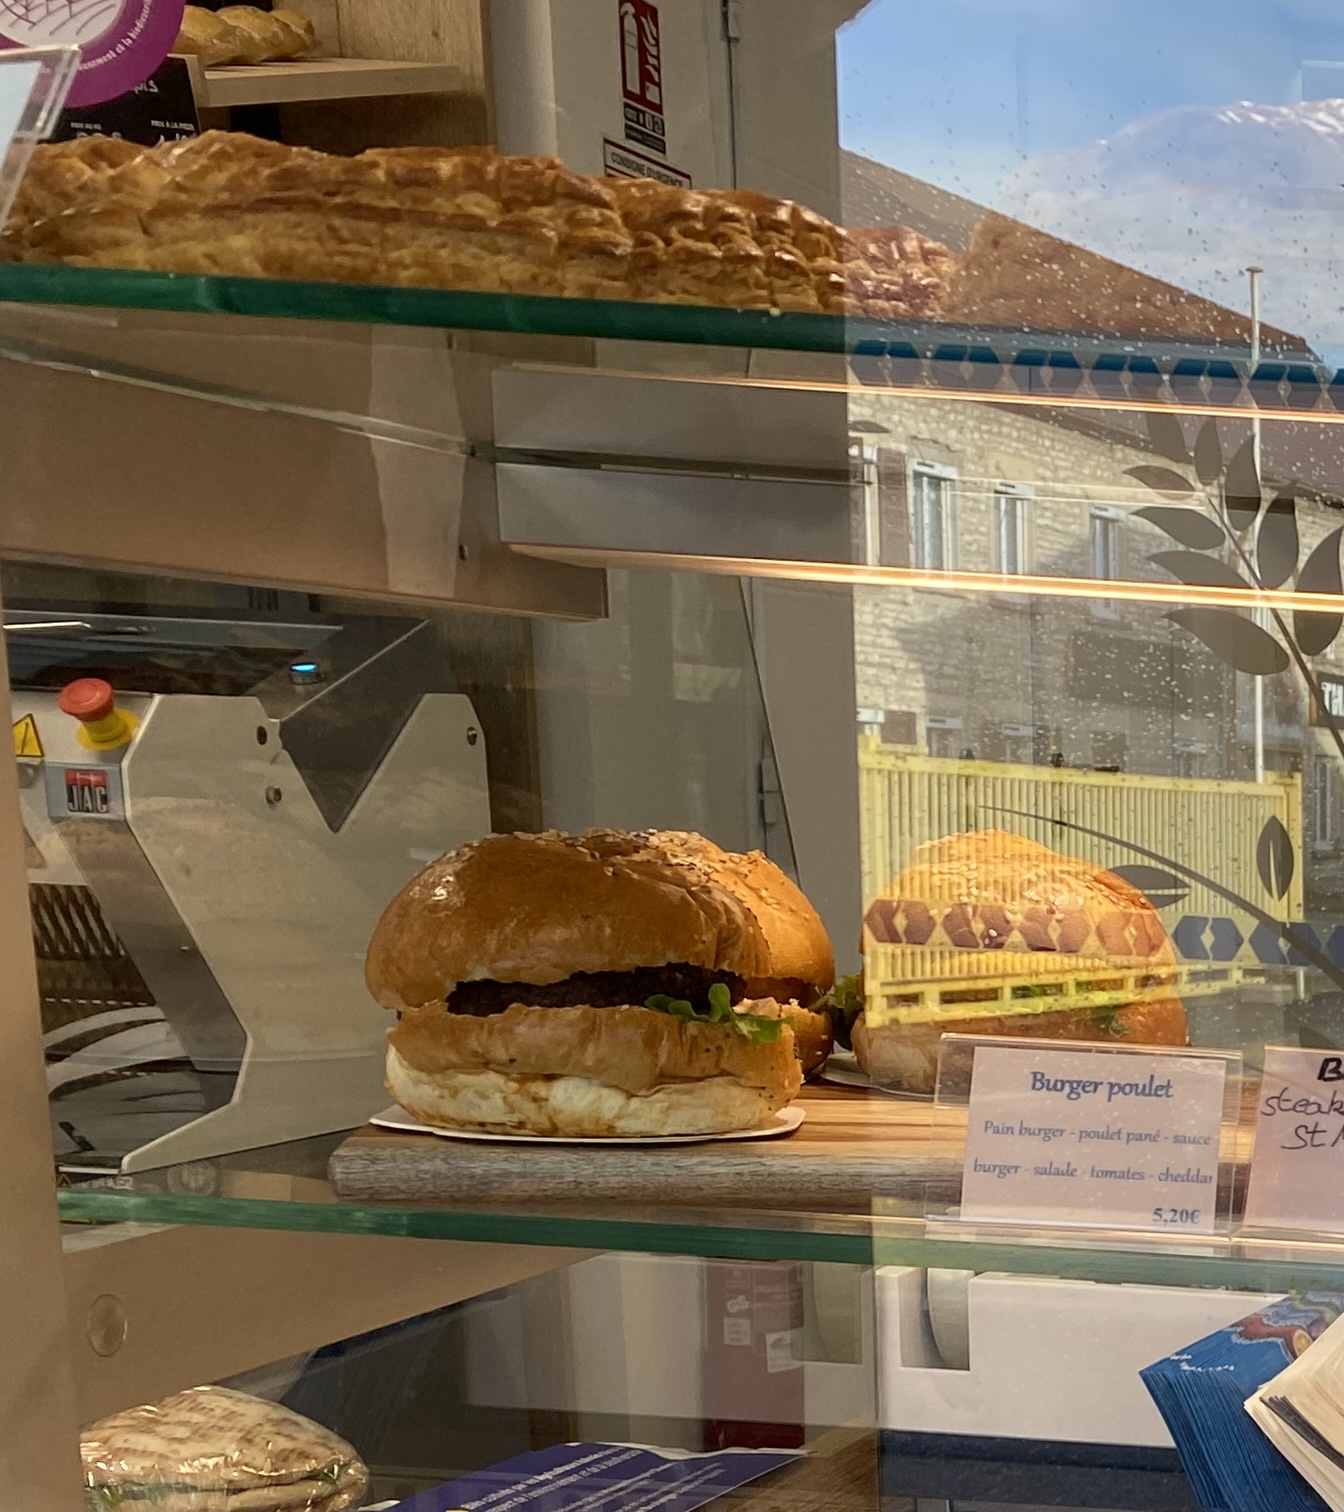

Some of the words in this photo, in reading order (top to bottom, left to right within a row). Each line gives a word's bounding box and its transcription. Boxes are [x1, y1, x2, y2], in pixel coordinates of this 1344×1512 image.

[67, 784, 108, 814] JAC
[1031, 1070, 1103, 1100] Burger
[1108, 1074, 1174, 1102] poulet
[984, 1120, 1015, 1136] Pain
[1018, 1120, 1067, 1142] burger
[1078, 1125, 1122, 1143] poulet
[1126, 1130, 1161, 1145] pané
[1172, 1131, 1212, 1146] sauce
[1281, 1121, 1328, 1151] St
[973, 1158, 1021, 1179] burger
[1033, 1161, 1078, 1178] salade
[1090, 1165, 1146, 1182] tomates
[1152, 1207, 1201, 1226] 5,20€
